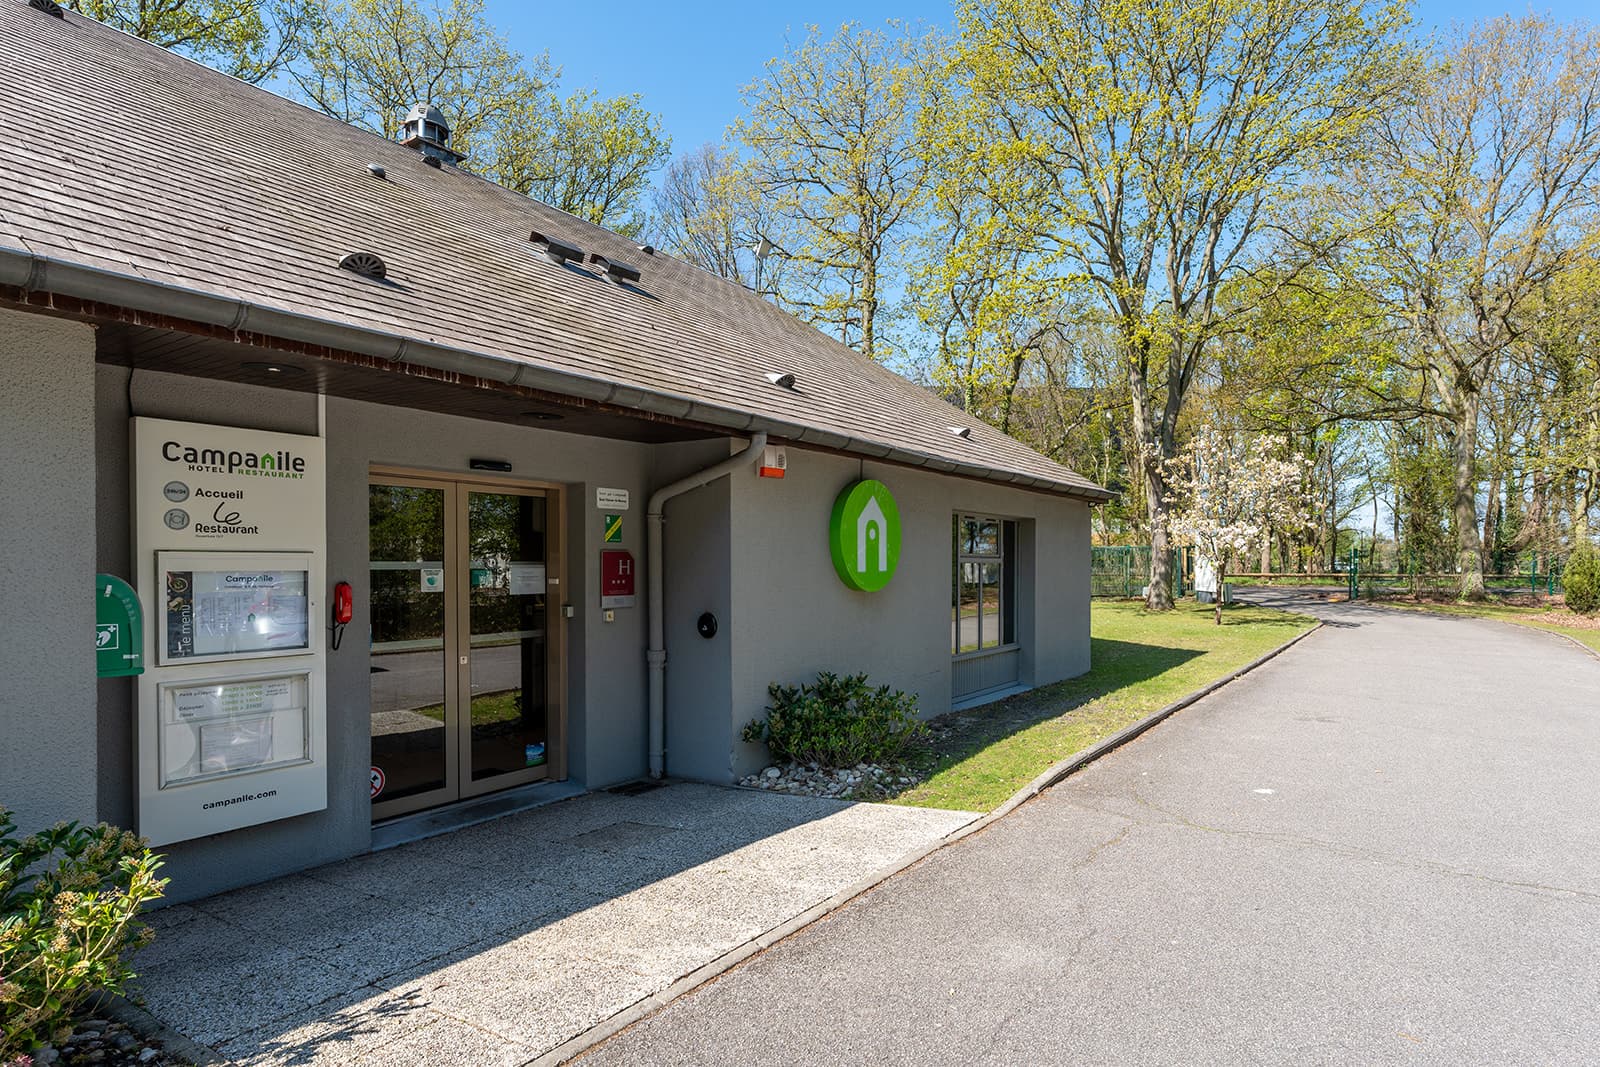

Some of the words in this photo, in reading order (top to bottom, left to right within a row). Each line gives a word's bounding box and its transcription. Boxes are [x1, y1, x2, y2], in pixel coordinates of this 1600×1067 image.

[162, 441, 305, 473] Campanile
[188, 464, 225, 474] HOTEL
[238, 468, 304, 479] RESTAURANT
[195, 487, 243, 499] Accueil
[195, 523, 259, 534] Restaurant
[619, 559, 630, 575] H
[182, 604, 191, 634] menu
[202, 789, 277, 810] campanile.com
